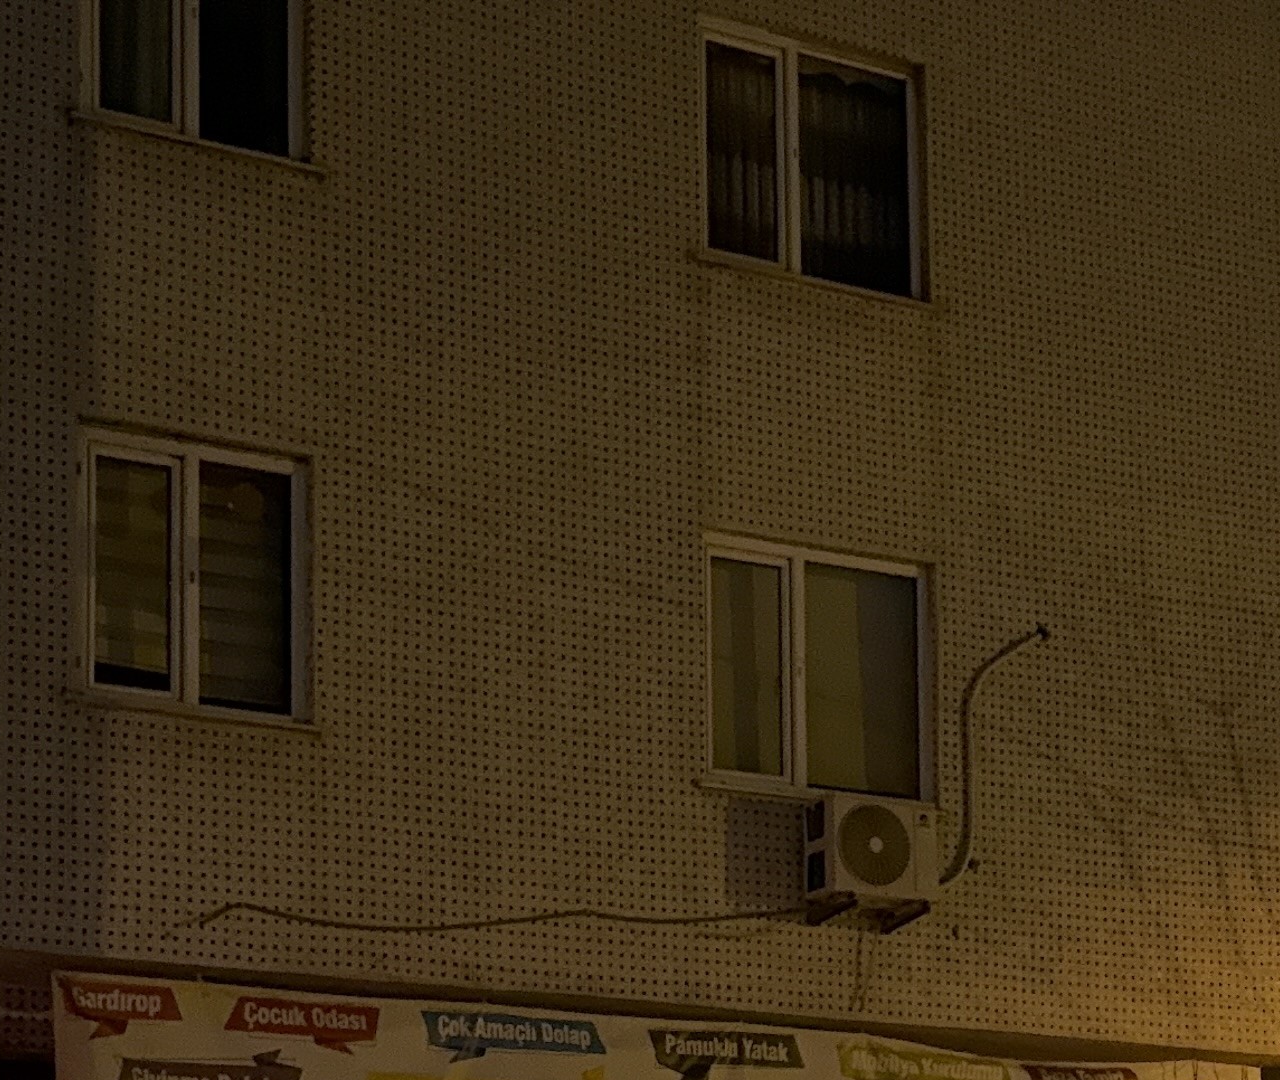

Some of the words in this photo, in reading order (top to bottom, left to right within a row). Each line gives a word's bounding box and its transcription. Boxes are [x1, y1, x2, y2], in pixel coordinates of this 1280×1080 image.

[244, 1001, 307, 1030] Çocuk
[312, 1007, 367, 1031] Odası
[437, 1015, 473, 1040] Çok
[474, 1017, 536, 1046] Amaçlı
[541, 1023, 591, 1048] Dolap
[742, 1037, 789, 1062] Yatak
